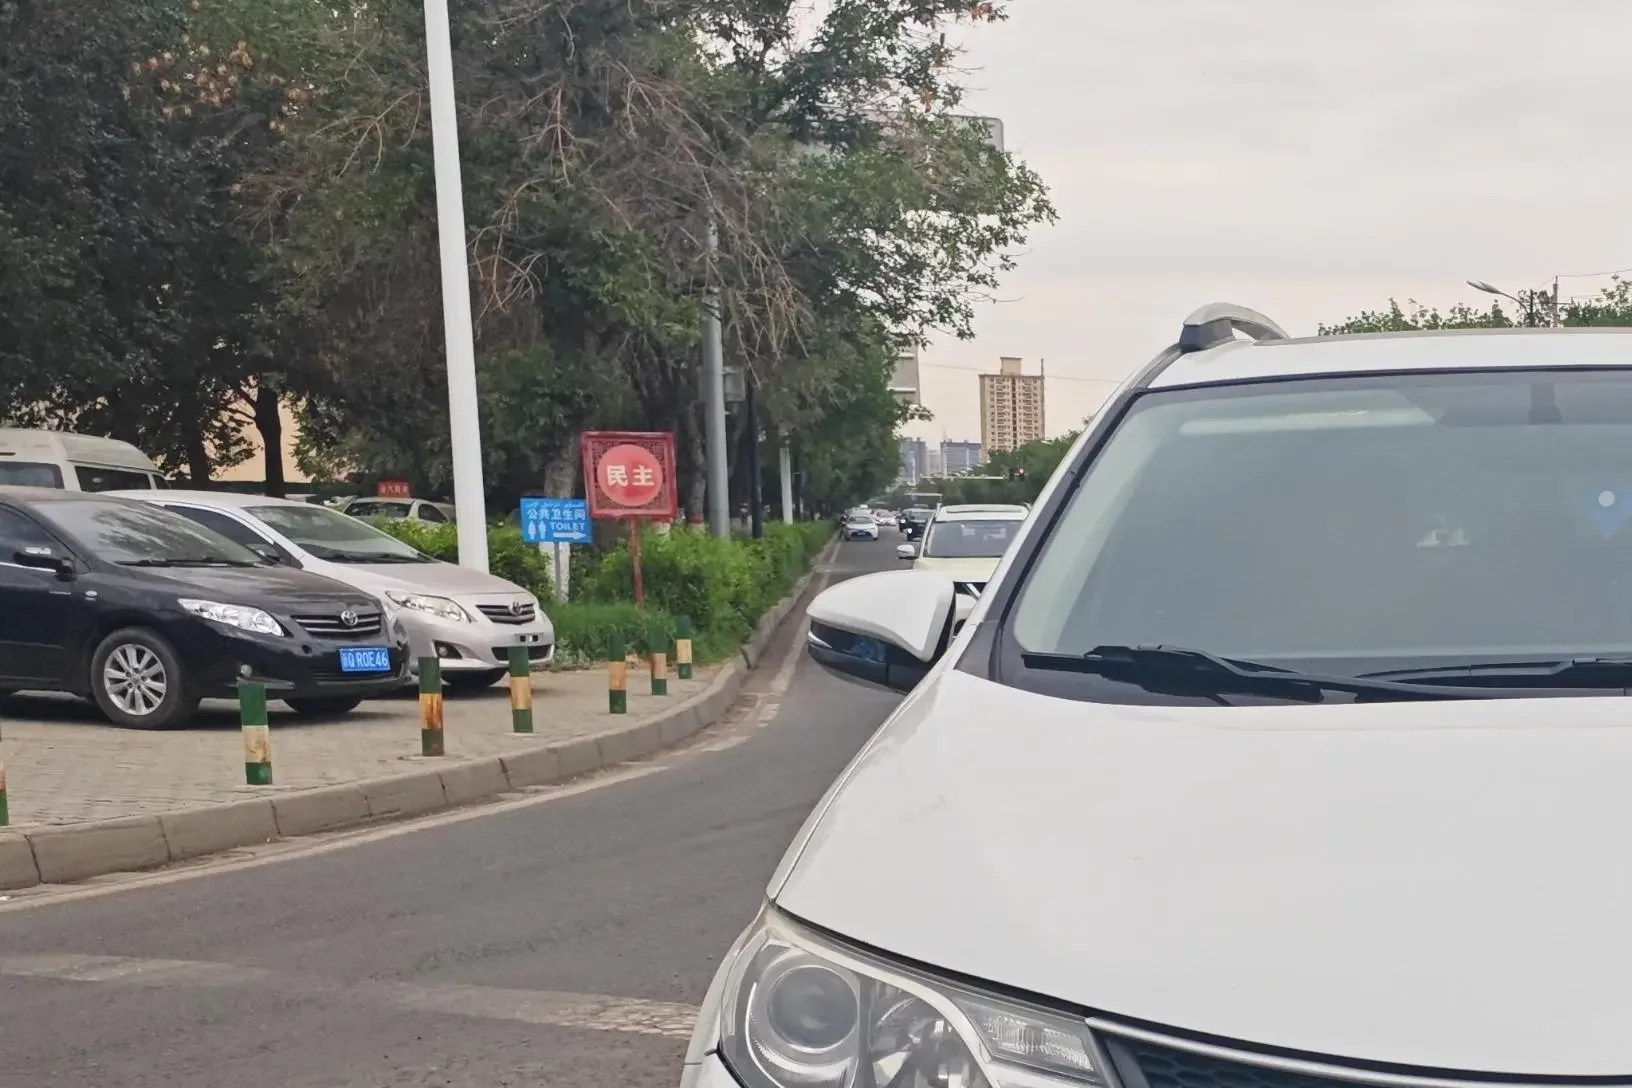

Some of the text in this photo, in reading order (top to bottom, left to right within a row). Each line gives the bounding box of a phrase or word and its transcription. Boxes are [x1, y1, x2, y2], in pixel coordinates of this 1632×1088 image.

[606, 464, 655, 487] 民主
[526, 508, 586, 520] 公共卫生间
[549, 522, 585, 531] TOILET
